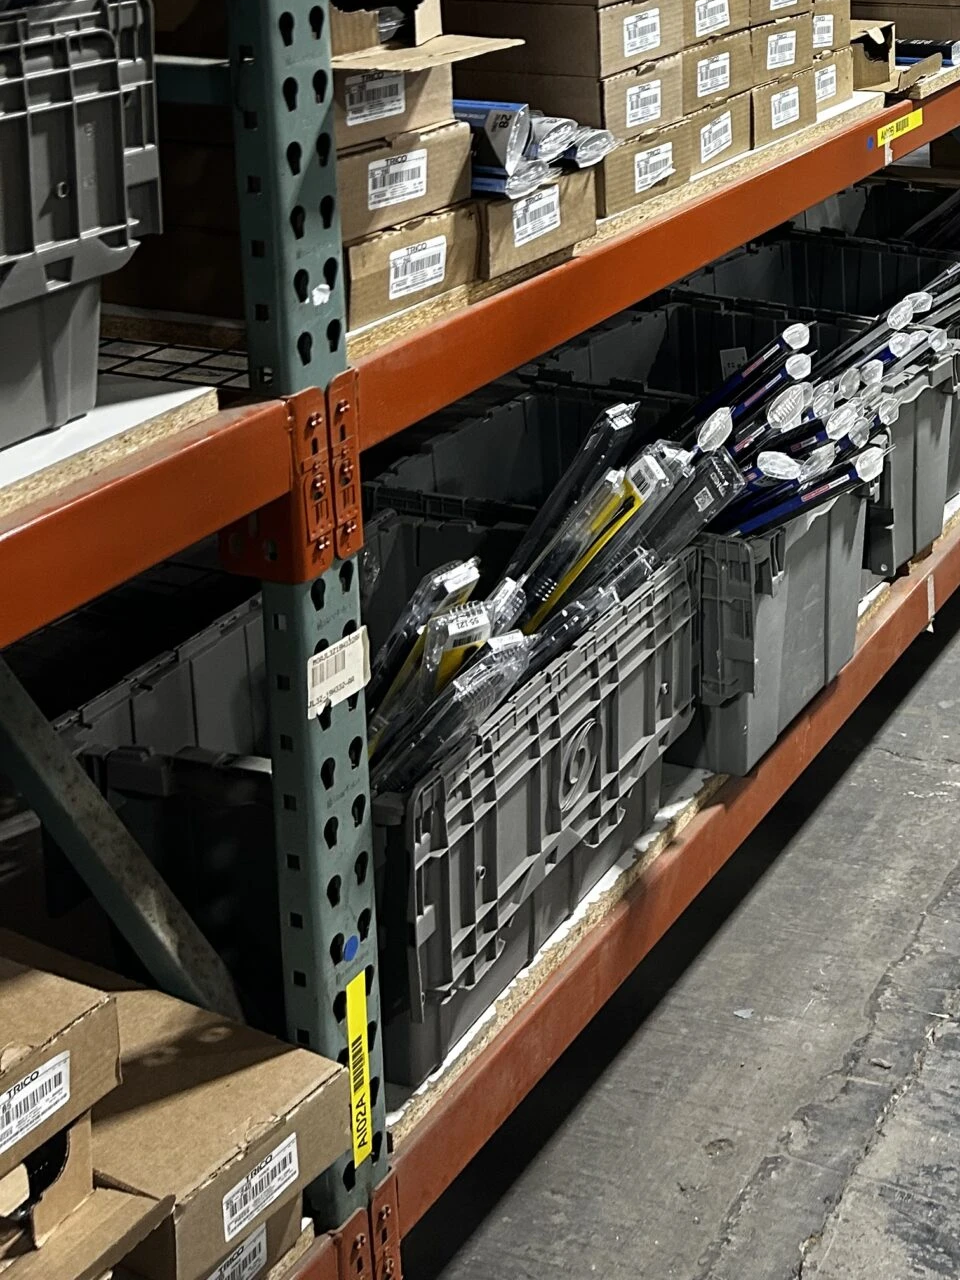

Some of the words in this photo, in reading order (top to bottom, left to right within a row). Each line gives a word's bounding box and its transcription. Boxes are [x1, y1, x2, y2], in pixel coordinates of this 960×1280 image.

[361, 70, 385, 81] TRICO
[385, 154, 408, 164] TRICO
[525, 192, 543, 205] TRICO
[406, 242, 427, 256] TRICO
[7, 1070, 40, 1100] TRICO
[355, 1092, 369, 1150] AI02A
[246, 1154, 273, 1184] TRICO
[218, 1245, 245, 1275] TRICO
